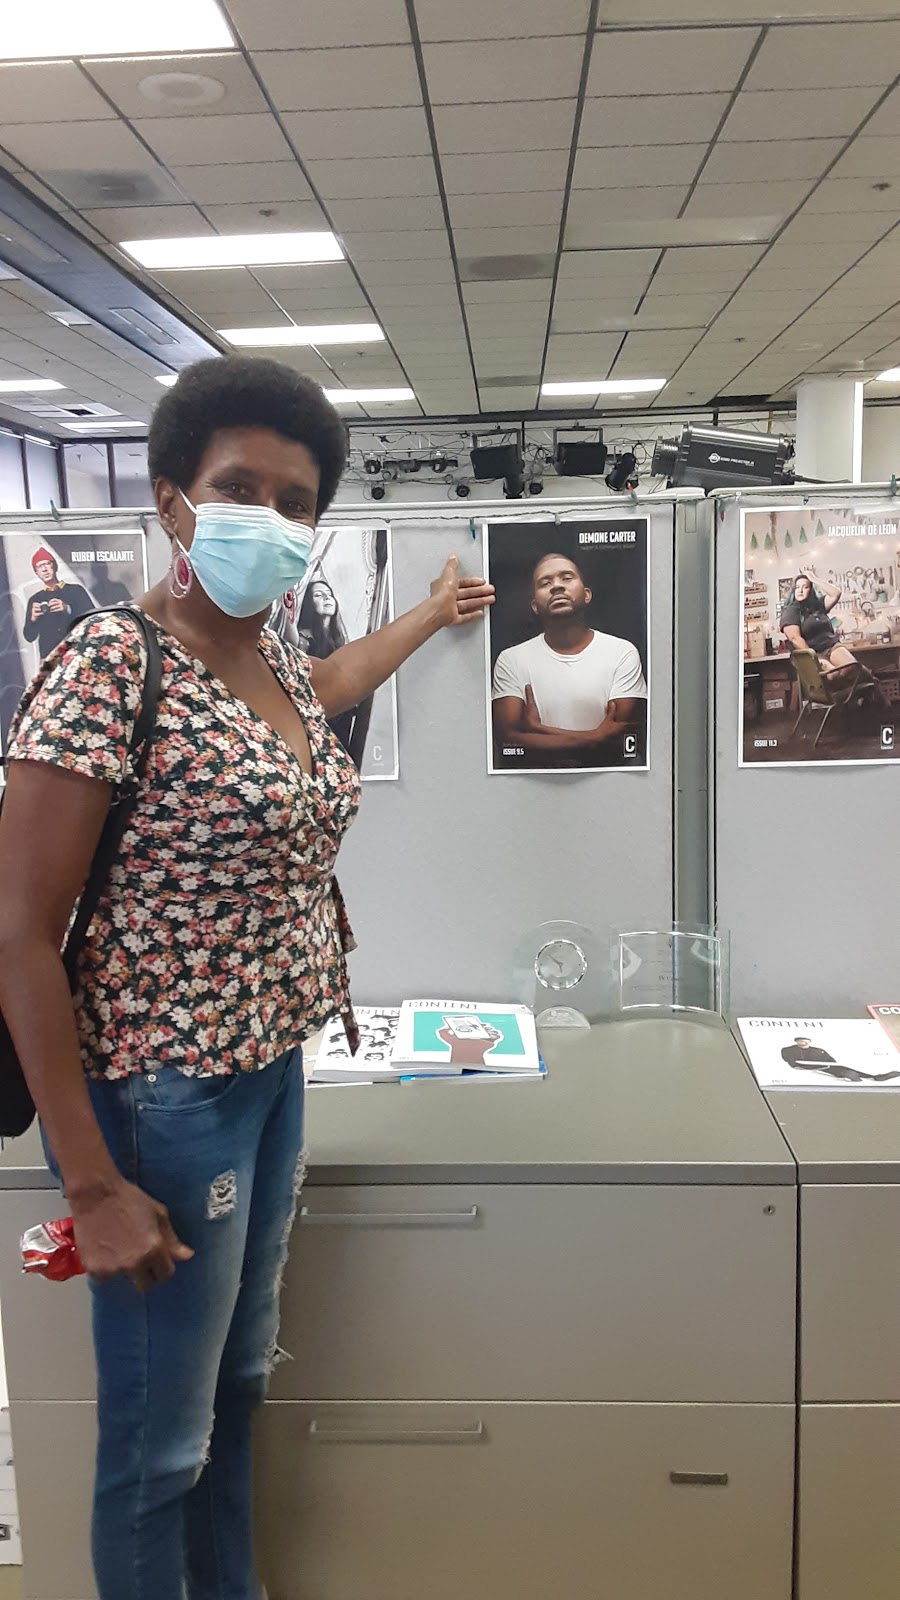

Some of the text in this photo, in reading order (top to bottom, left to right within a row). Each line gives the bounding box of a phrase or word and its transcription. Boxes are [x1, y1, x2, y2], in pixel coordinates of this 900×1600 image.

[828, 524, 897, 538] JACQUELIN DE LEON
[579, 531, 636, 544] DEMONE CARTER
[71, 550, 135, 562] RUBEN ESCALANTE
[882, 727, 893, 745] C
[625, 735, 635, 753] C
[754, 739, 768, 747] ISSUE
[373, 745, 382, 761] C
[502, 747, 525, 756] ISSUE 9.5
[408, 1001, 478, 1011] CONTENT
[749, 1020, 825, 1029] CONTENT
